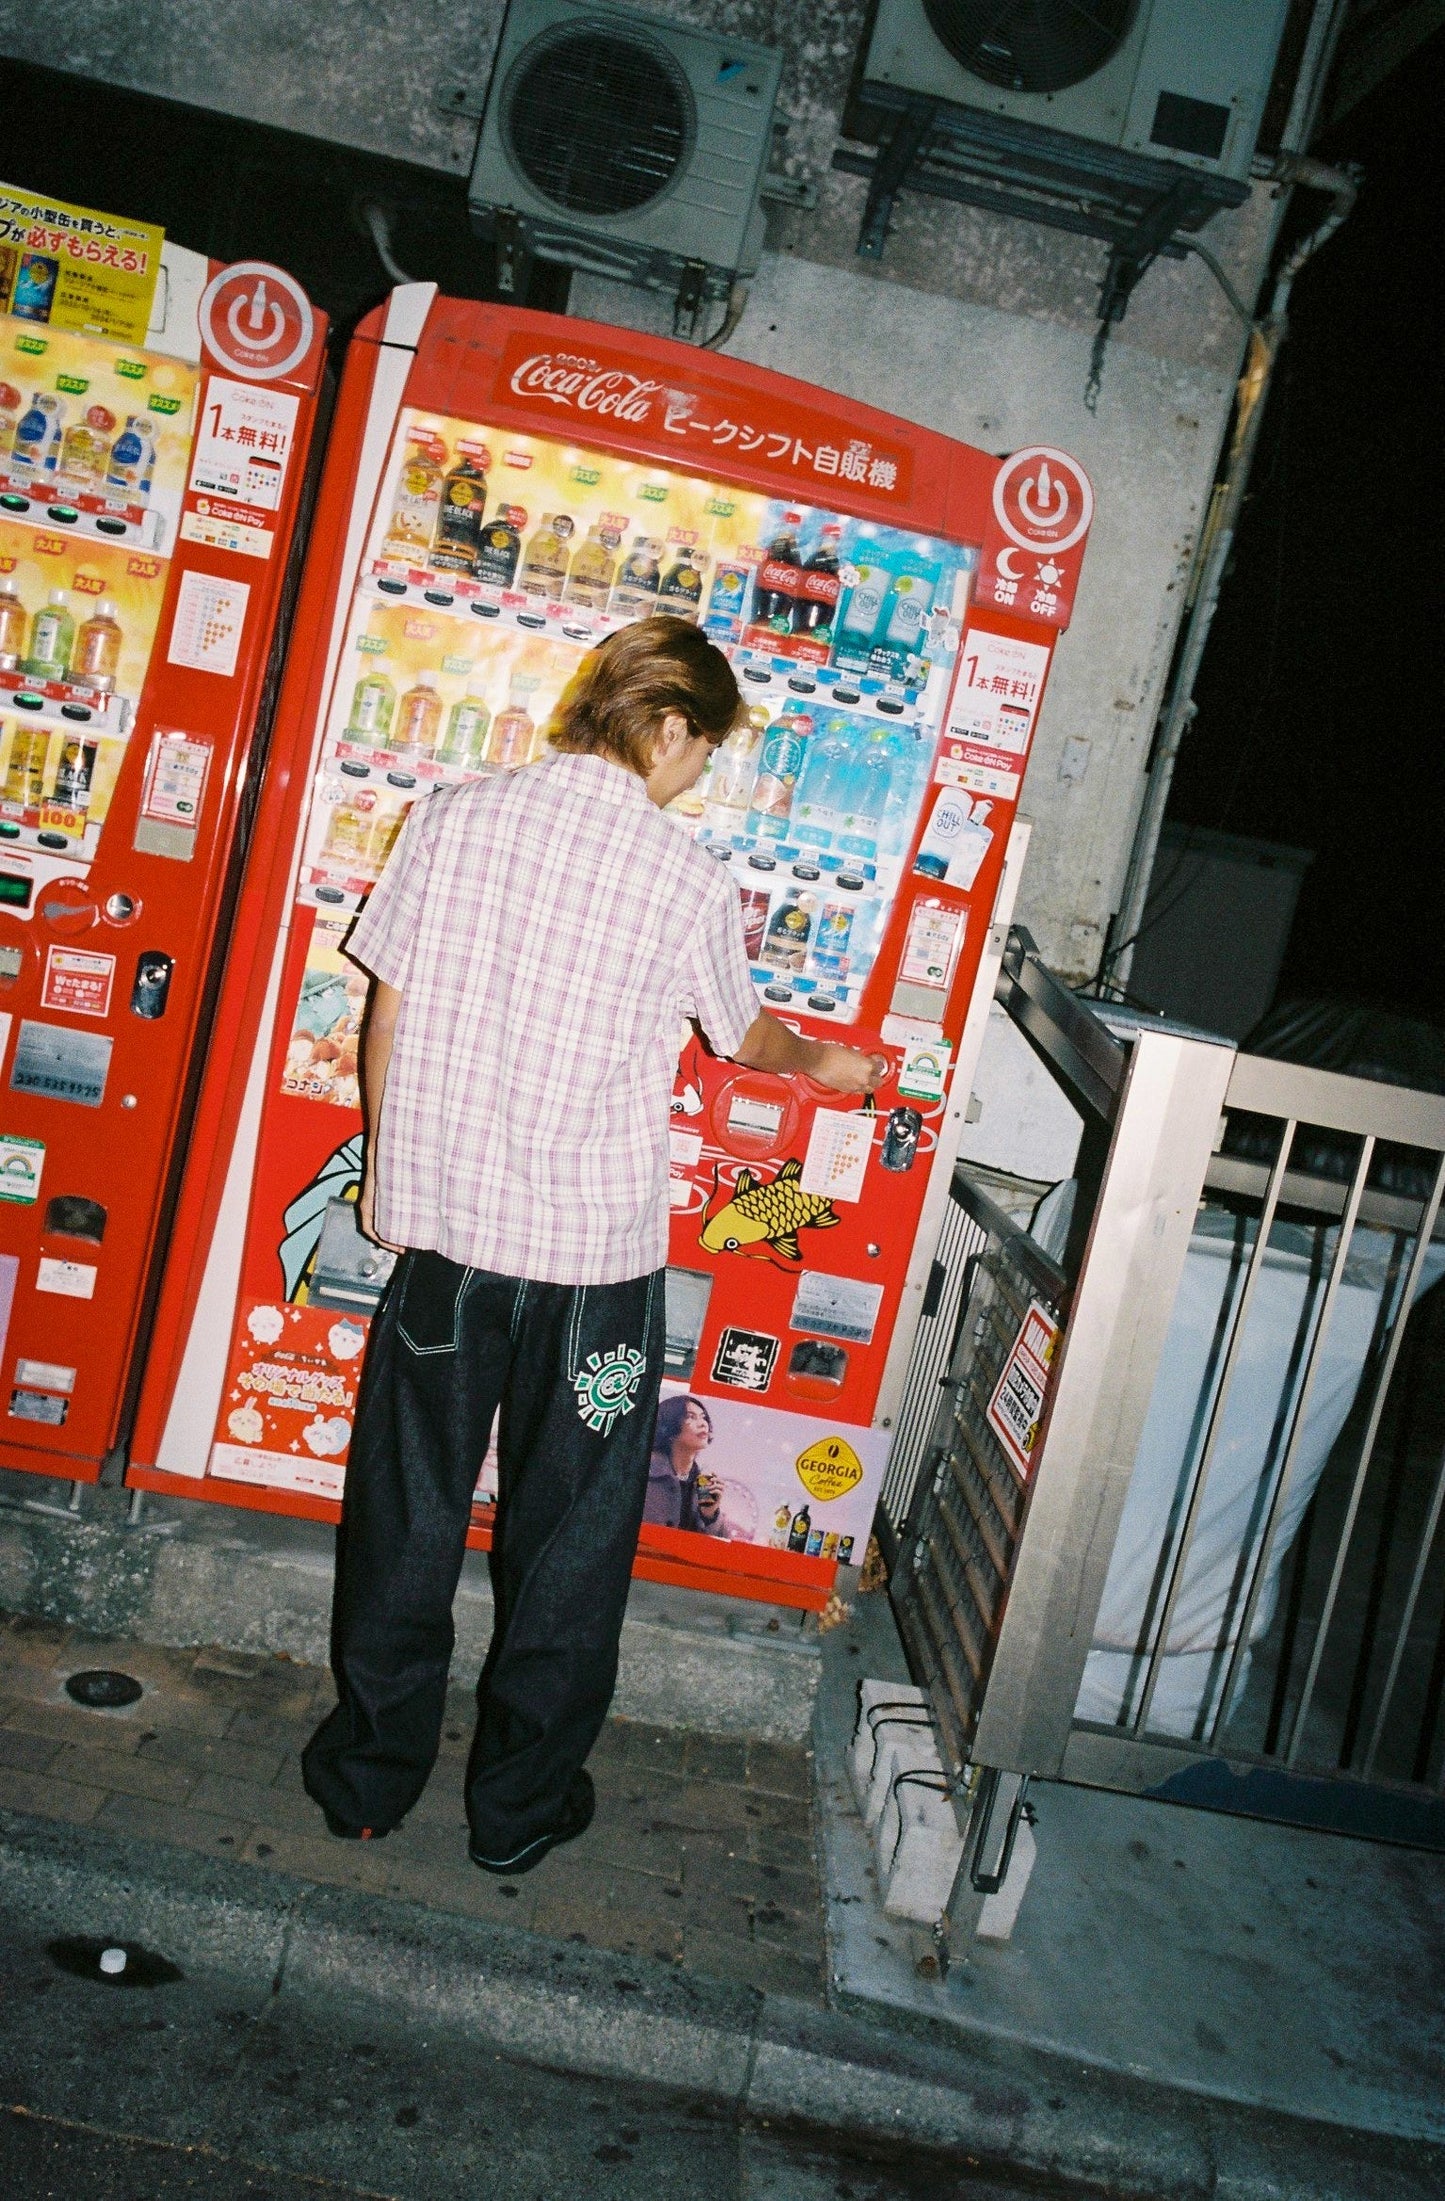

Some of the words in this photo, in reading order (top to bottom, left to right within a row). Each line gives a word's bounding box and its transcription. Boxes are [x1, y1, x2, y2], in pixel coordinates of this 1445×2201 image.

[510, 353, 664, 423] Coca-Cola
[210, 403, 287, 456] 1本無料!
[247, 514, 265, 528] Pay
[994, 590, 1015, 606] ON
[1030, 600, 1057, 617] OFF
[967, 654, 1037, 703] 1本無料!
[996, 758, 1013, 771] Pay
[41, 810, 77, 828] 100
[936, 818, 957, 832] OUT
[286, 1078, 323, 1094] コナン
[800, 1458, 858, 1480] GEORGIA
[809, 1473, 843, 1488] Coffee
